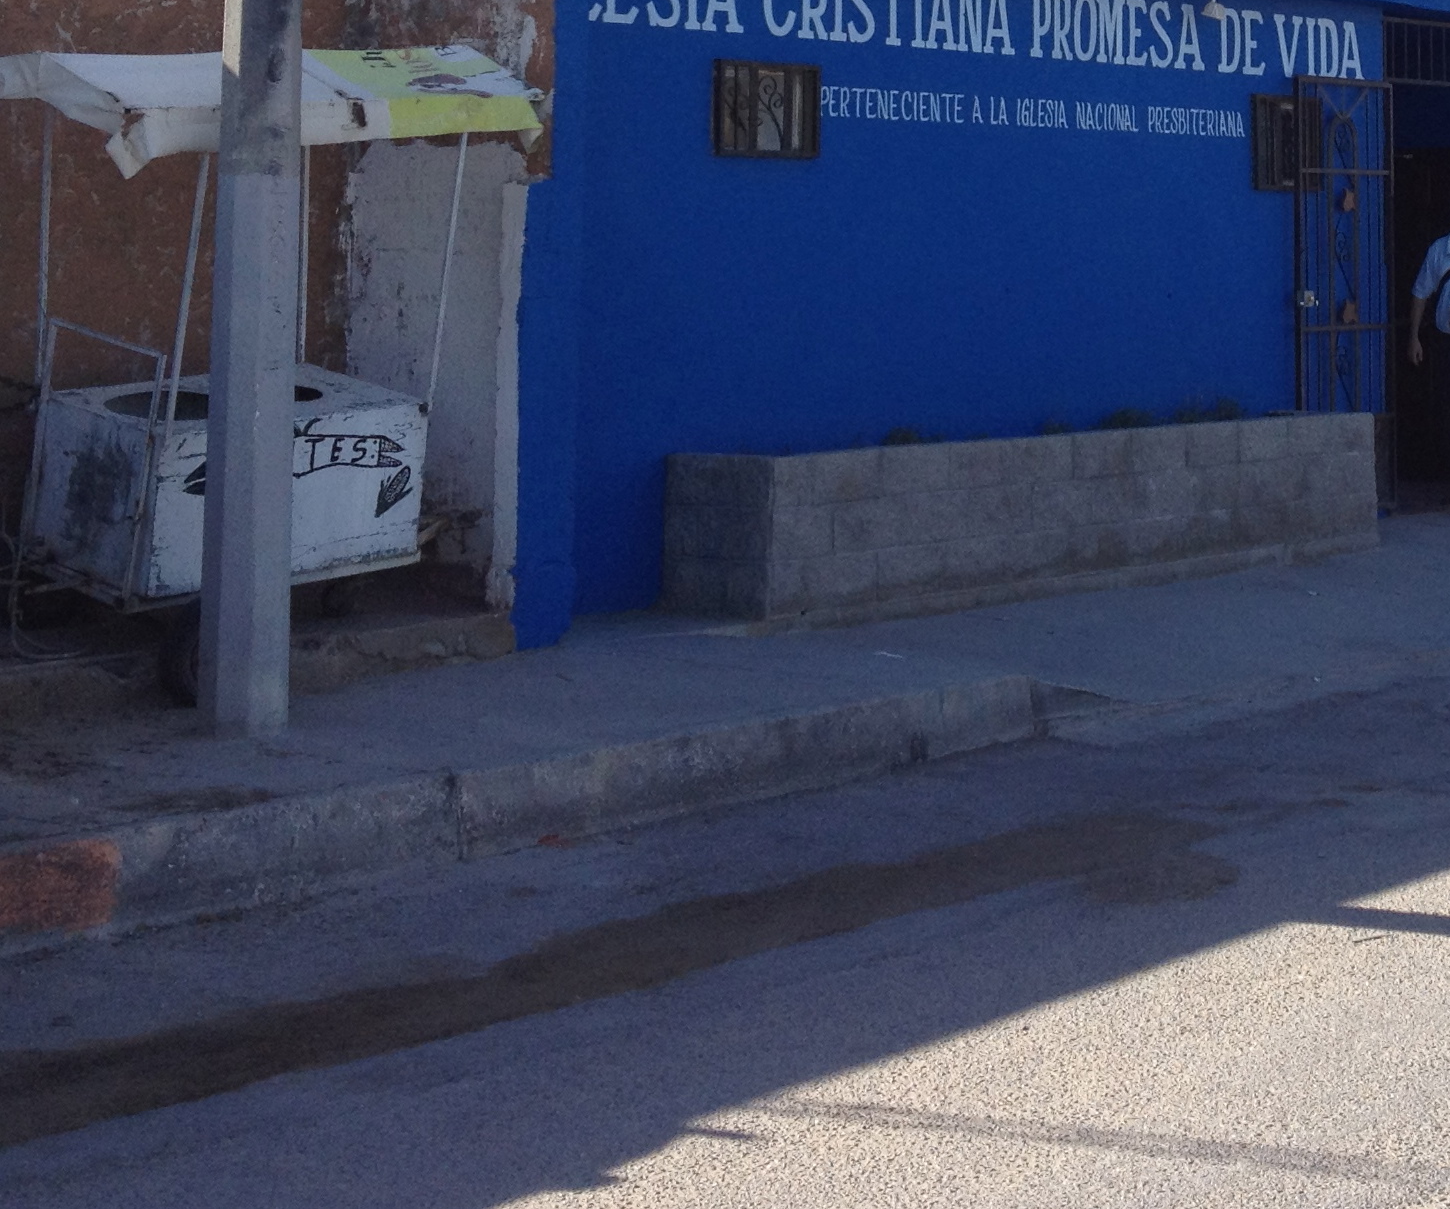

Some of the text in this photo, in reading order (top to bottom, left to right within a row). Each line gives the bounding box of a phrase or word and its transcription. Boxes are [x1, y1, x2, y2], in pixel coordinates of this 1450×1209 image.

[1217, 7, 1266, 76] DE
[1273, 13, 1365, 80] VIDA
[820, 85, 1245, 138] PERTENECIENTE A LA IGLESIA NACIONAL PRESBITERIANA
[304, 437, 368, 471] TES
